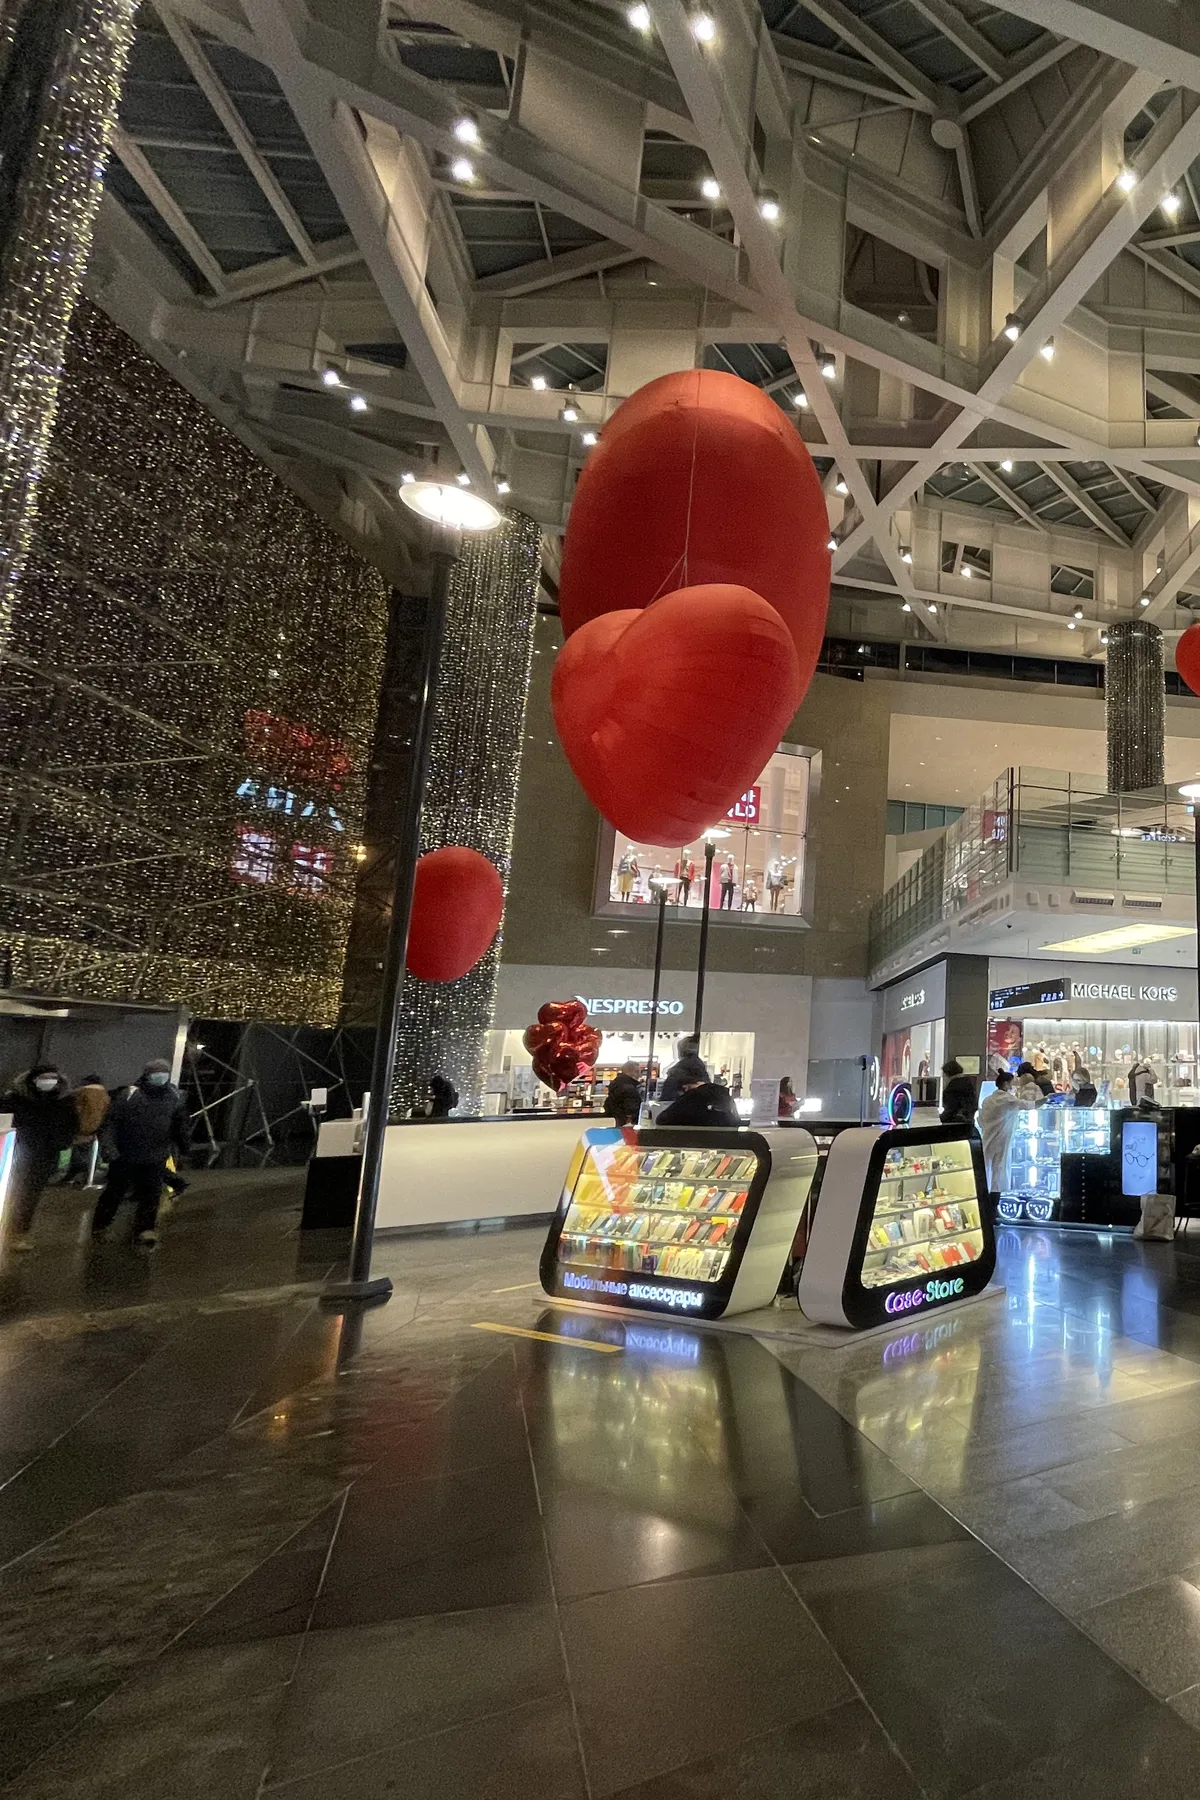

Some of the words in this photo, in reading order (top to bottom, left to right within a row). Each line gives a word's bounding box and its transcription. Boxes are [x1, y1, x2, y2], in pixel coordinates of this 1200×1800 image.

[1072, 983, 1136, 1000] MICHAEL
[1139, 986, 1178, 1001] KORS
[563, 1272, 628, 1295] Мобильные
[628, 1283, 704, 1308] аксессуары
